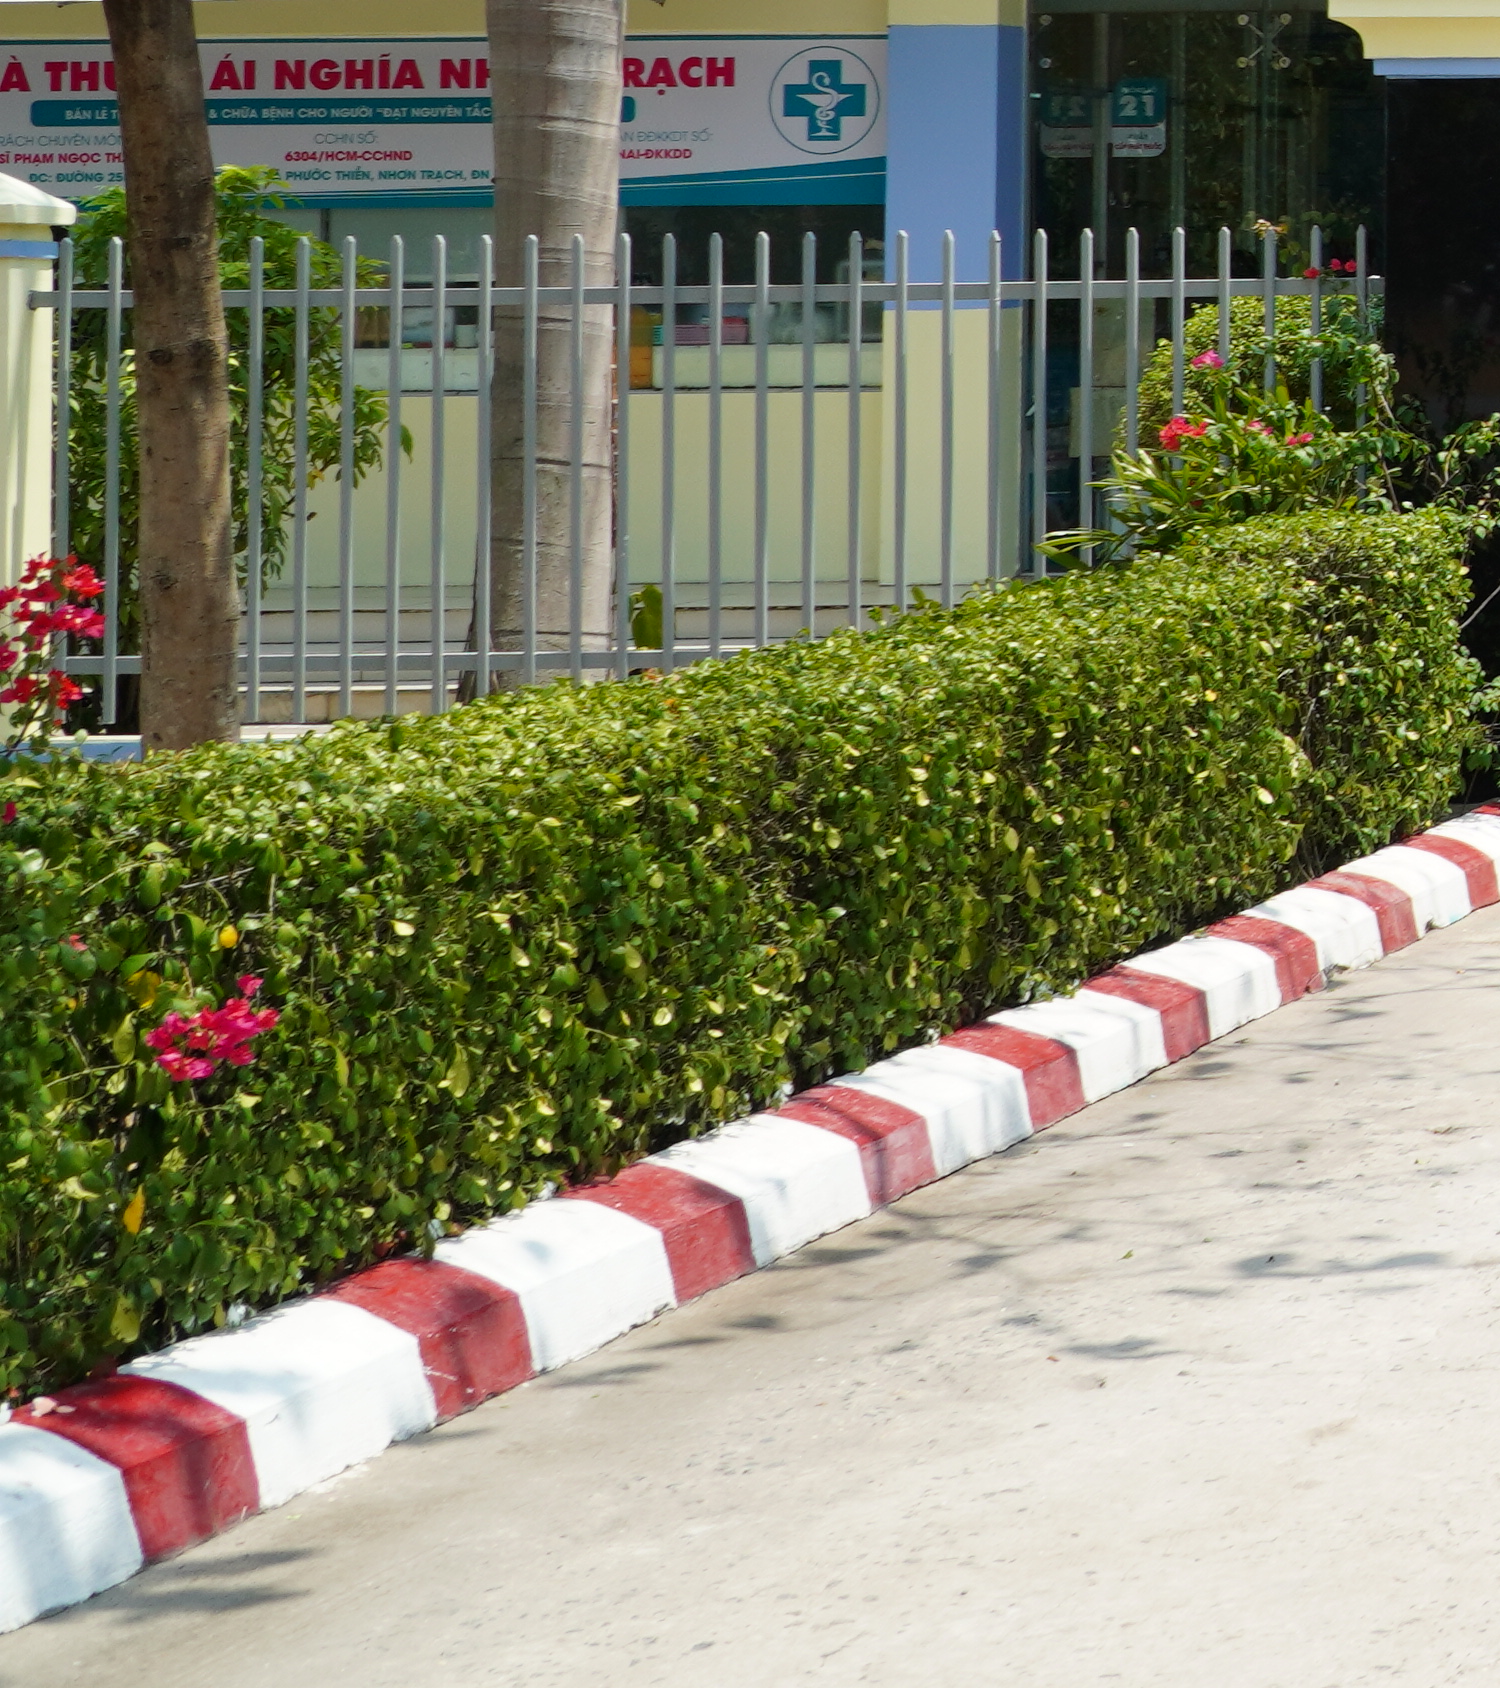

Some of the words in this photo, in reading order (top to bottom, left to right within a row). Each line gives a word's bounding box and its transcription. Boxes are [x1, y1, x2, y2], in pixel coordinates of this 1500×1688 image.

[209, 53, 256, 90] ÁI
[274, 52, 425, 90] NGHĨA
[622, 56, 736, 96] RẠCH
[261, 105, 294, 121] BỆNH
[298, 109, 328, 119] CHO
[1118, 94, 1156, 117] 21
[0, 132, 34, 147] RÁCH
[314, 132, 353, 145] CCHN
[14, 152, 54, 167] PHẠM
[58, 152, 101, 166] NGỌC
[105, 152, 124, 163] TH
[56, 169, 104, 183] ĐƯỜNG
[108, 172, 124, 182] 25
[285, 168, 331, 181] PHƯỚC
[378, 168, 416, 180] NHƠN
